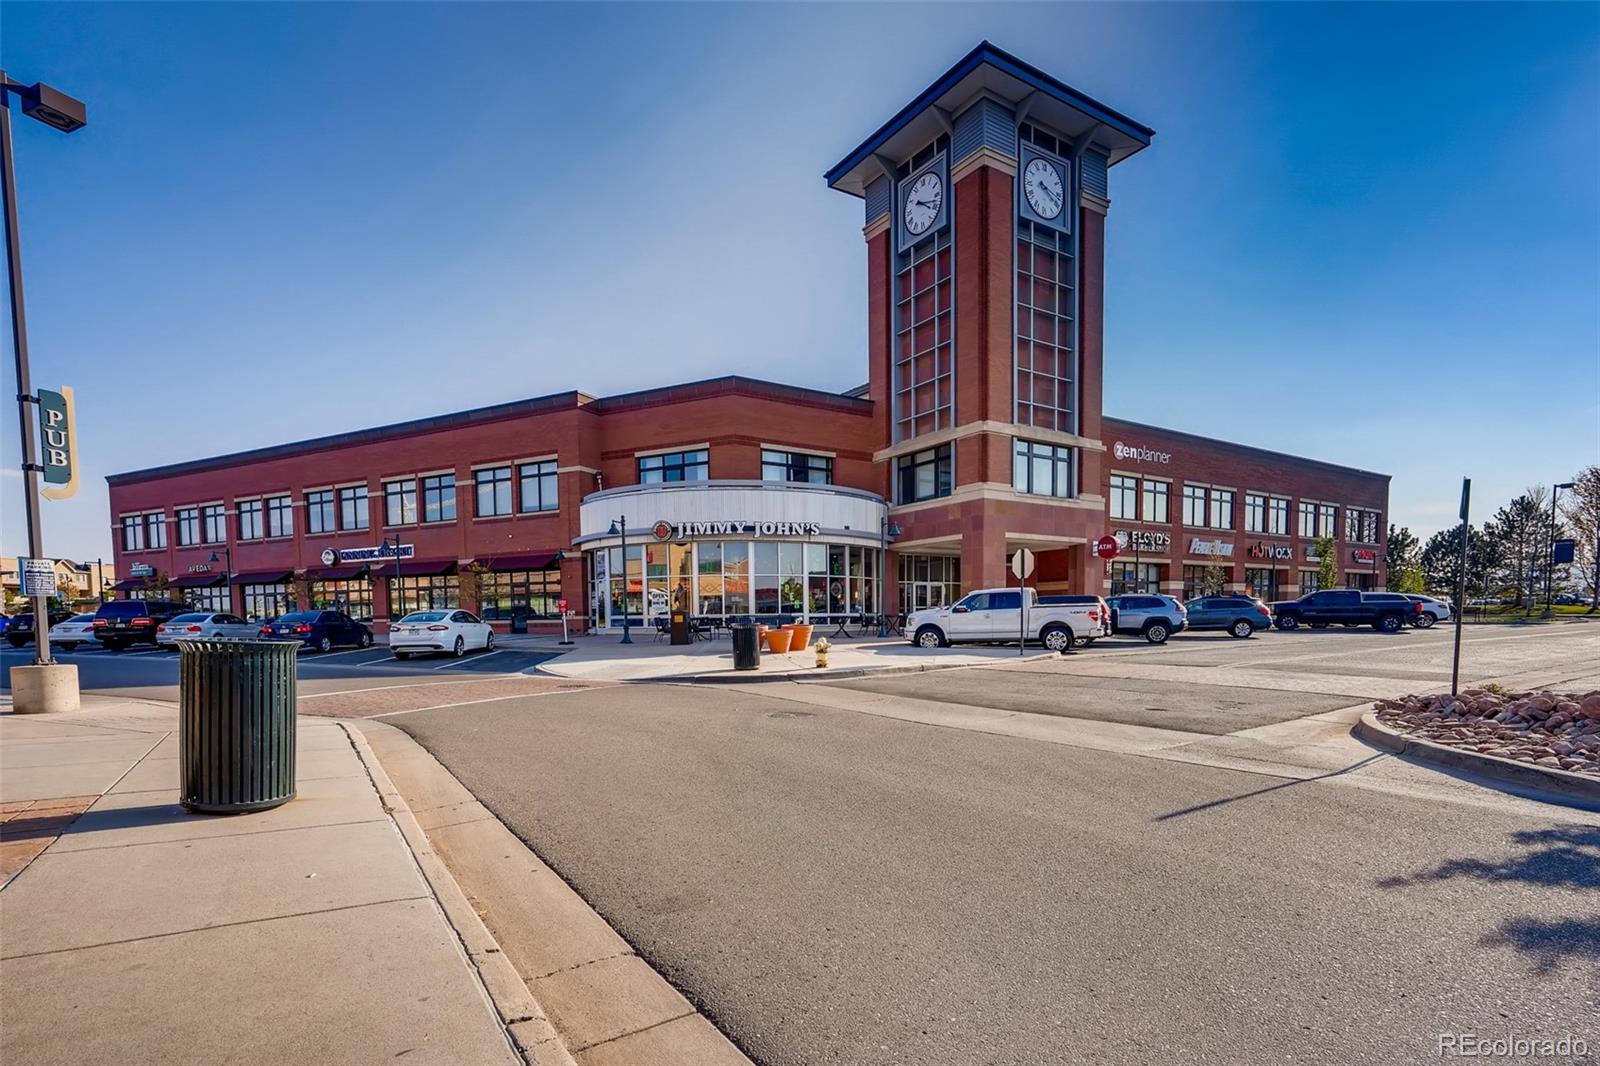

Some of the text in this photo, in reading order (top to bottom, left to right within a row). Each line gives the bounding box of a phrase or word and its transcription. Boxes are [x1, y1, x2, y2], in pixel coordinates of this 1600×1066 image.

[45, 409, 68, 467] PUB
[677, 521, 747, 539] JIMMY
[754, 521, 821, 538] JOHN'S
